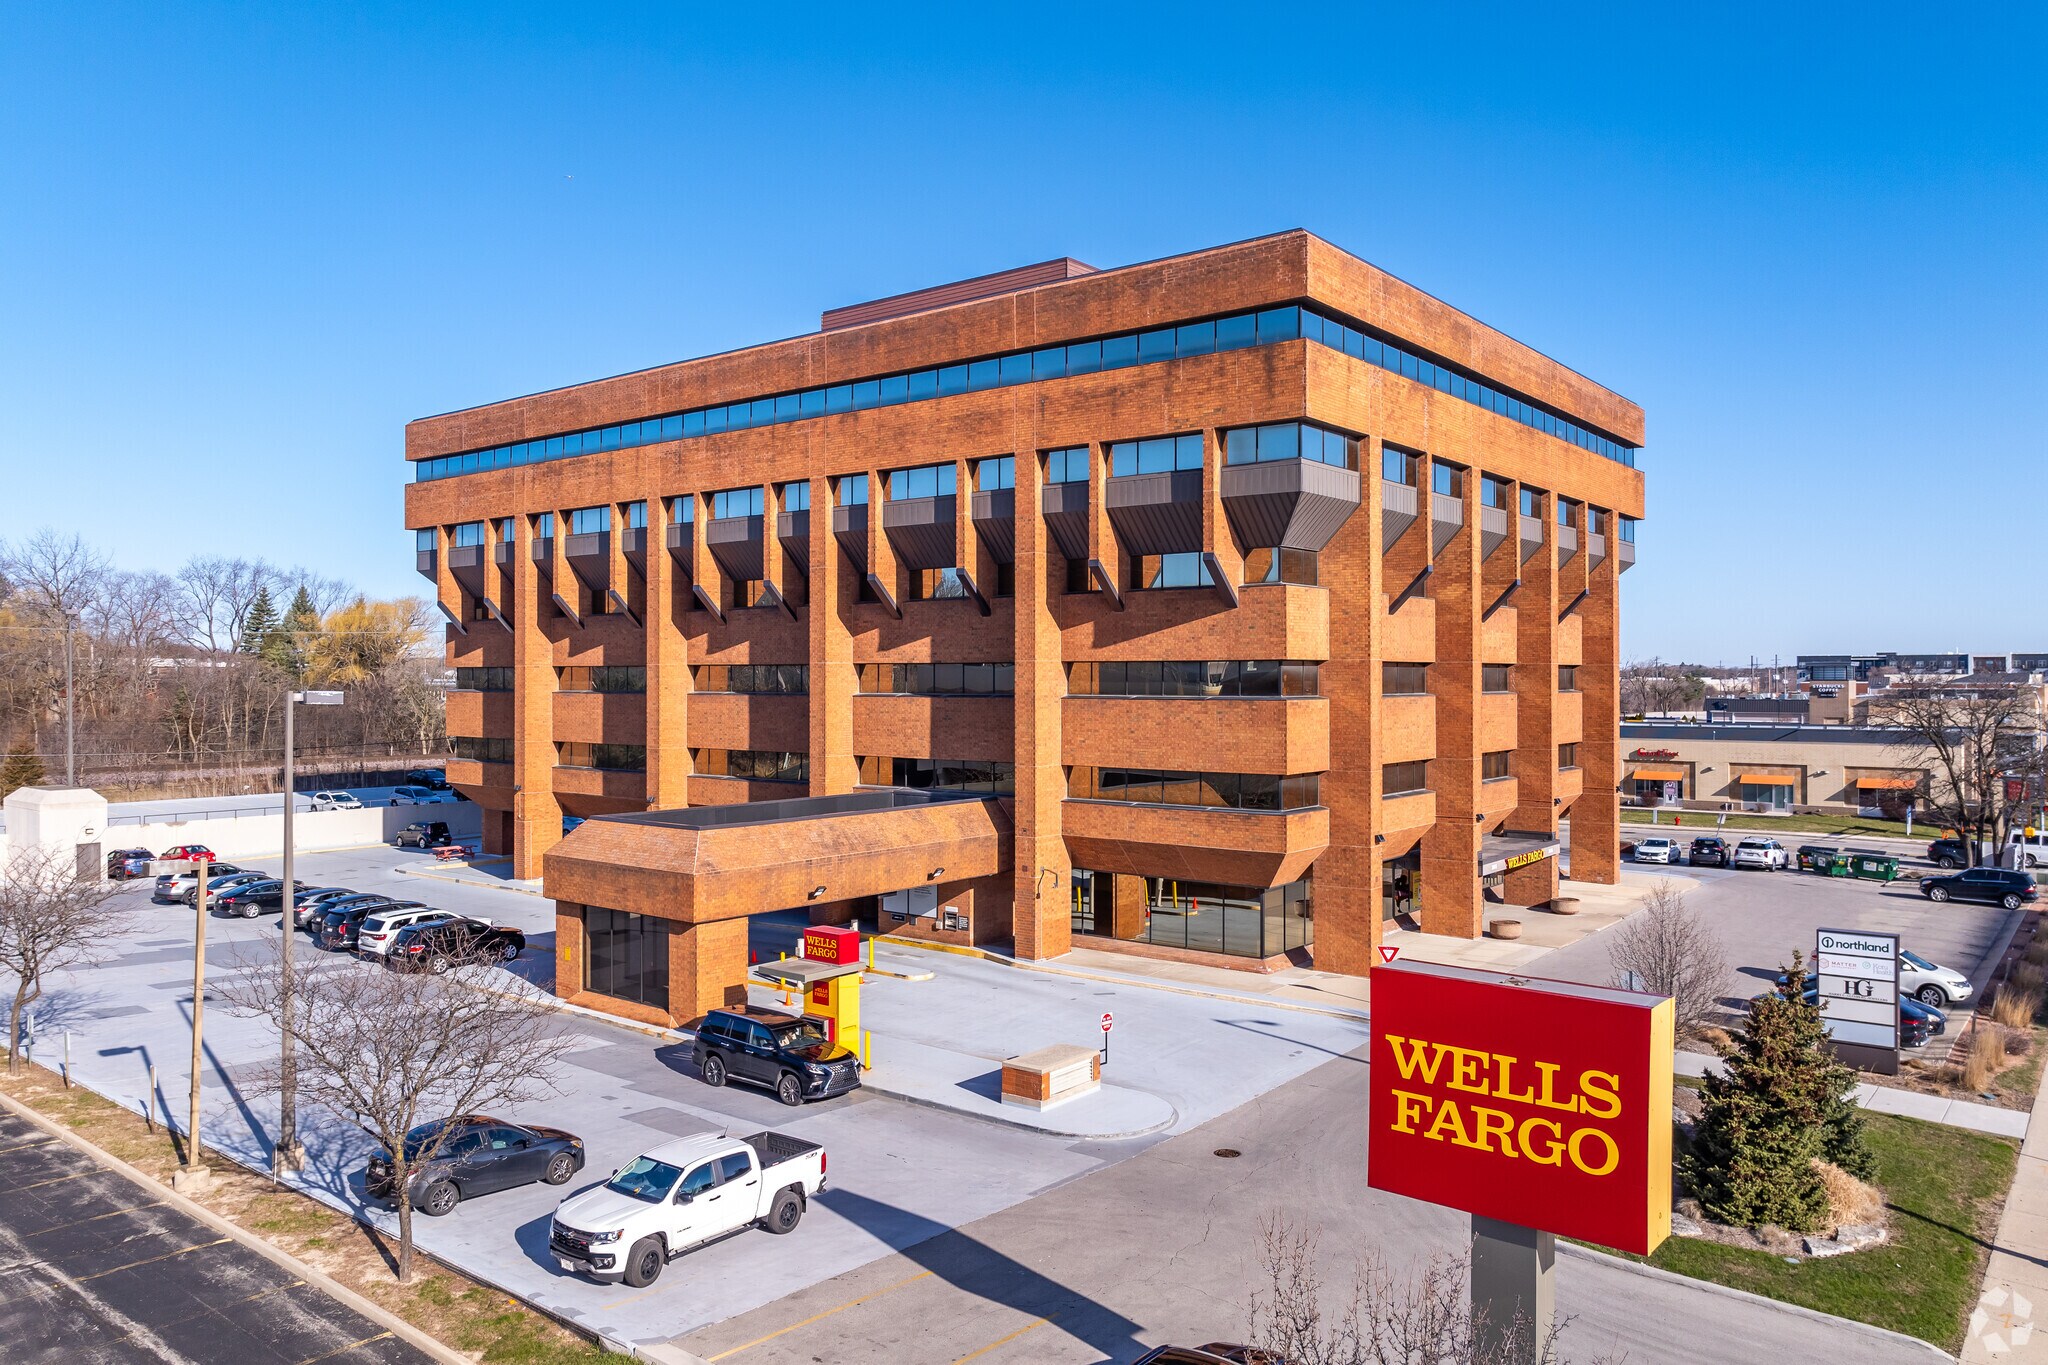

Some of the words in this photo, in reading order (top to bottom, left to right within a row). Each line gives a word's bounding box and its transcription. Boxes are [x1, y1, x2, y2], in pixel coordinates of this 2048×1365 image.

[1508, 854, 1527, 869] WELLS
[1528, 849, 1544, 863] FARGO
[806, 935, 837, 949] WELLS
[1836, 941, 1889, 953] northland
[807, 945, 837, 959] FARGO
[1385, 1034, 1622, 1119] WELLS
[1391, 1089, 1620, 1176] FARGO
